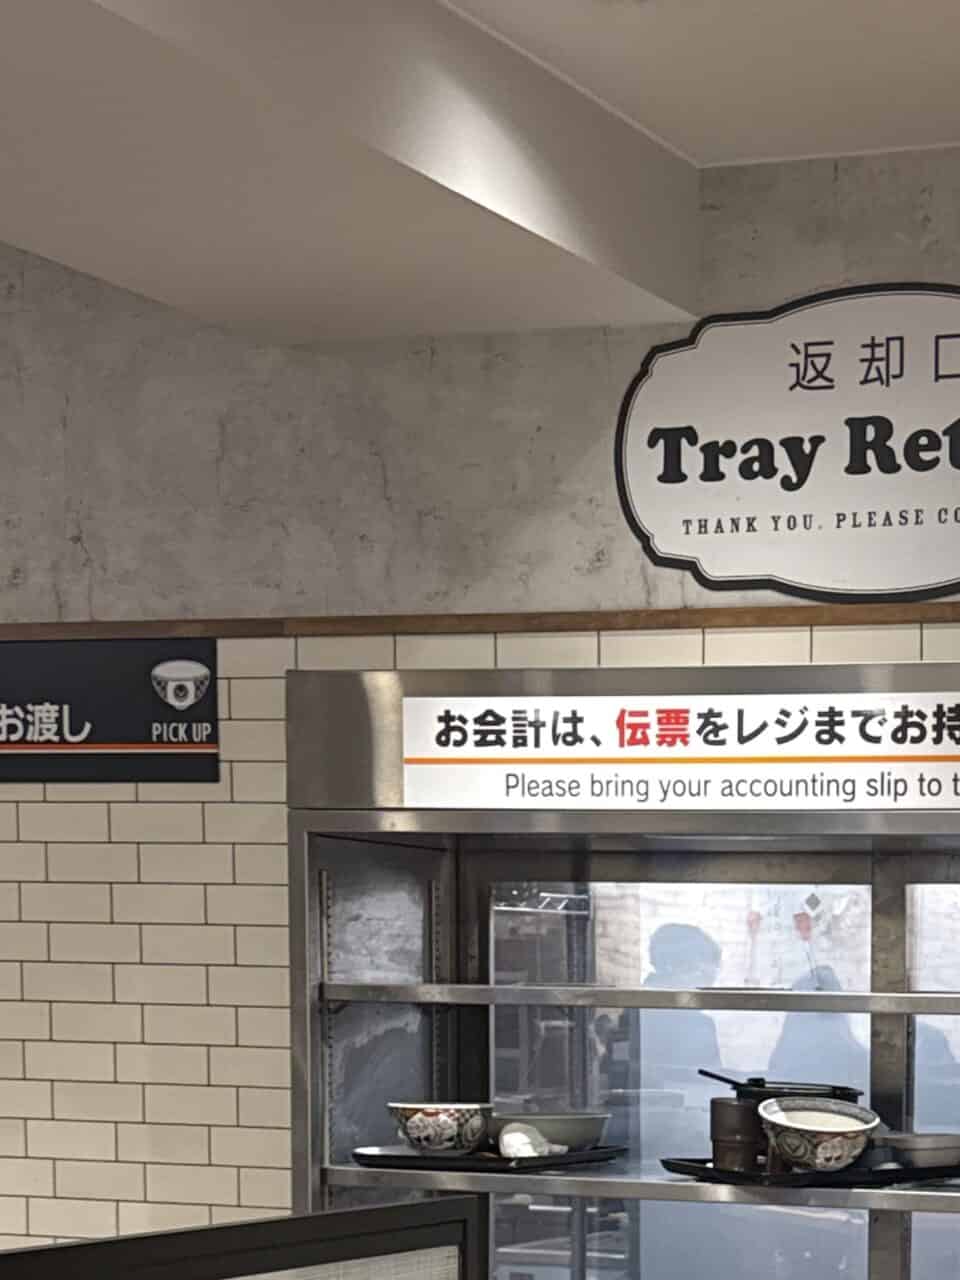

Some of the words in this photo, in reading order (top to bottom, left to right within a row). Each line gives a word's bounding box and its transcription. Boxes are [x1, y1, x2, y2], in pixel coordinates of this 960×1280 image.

[646, 425, 827, 492] Tray
[682, 516, 758, 536] THANK
[835, 508, 924, 529] PLEASE
[151, 722, 188, 742] PICK
[192, 722, 212, 742] UP
[505, 772, 581, 798] Please
[590, 772, 649, 803] bring
[658, 779, 712, 803] your
[720, 771, 856, 803] accounting
[866, 770, 908, 803] slip
[917, 772, 943, 797] to
